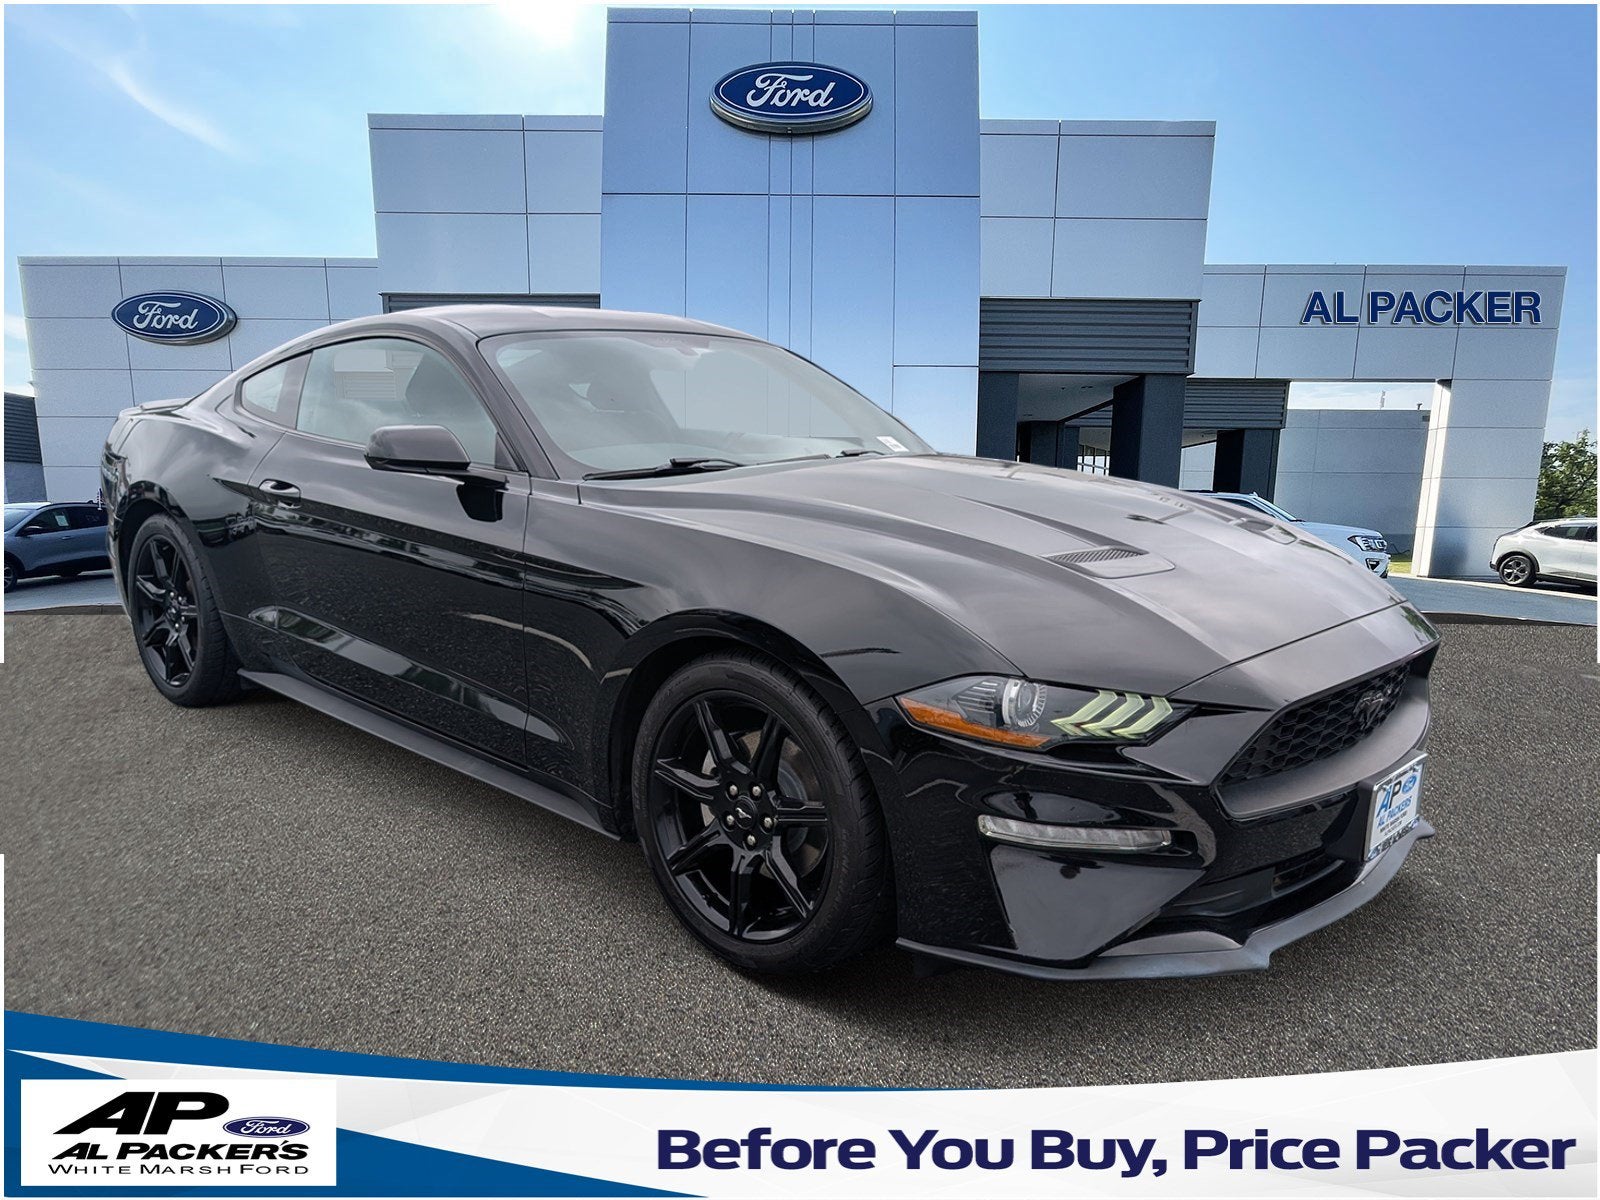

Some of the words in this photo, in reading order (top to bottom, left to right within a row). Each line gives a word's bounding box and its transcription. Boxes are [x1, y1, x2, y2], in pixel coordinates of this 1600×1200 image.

[746, 73, 836, 107] Ford
[133, 301, 199, 329] Ford
[1302, 290, 1359, 324] AL
[1368, 289, 1542, 325] PACKER
